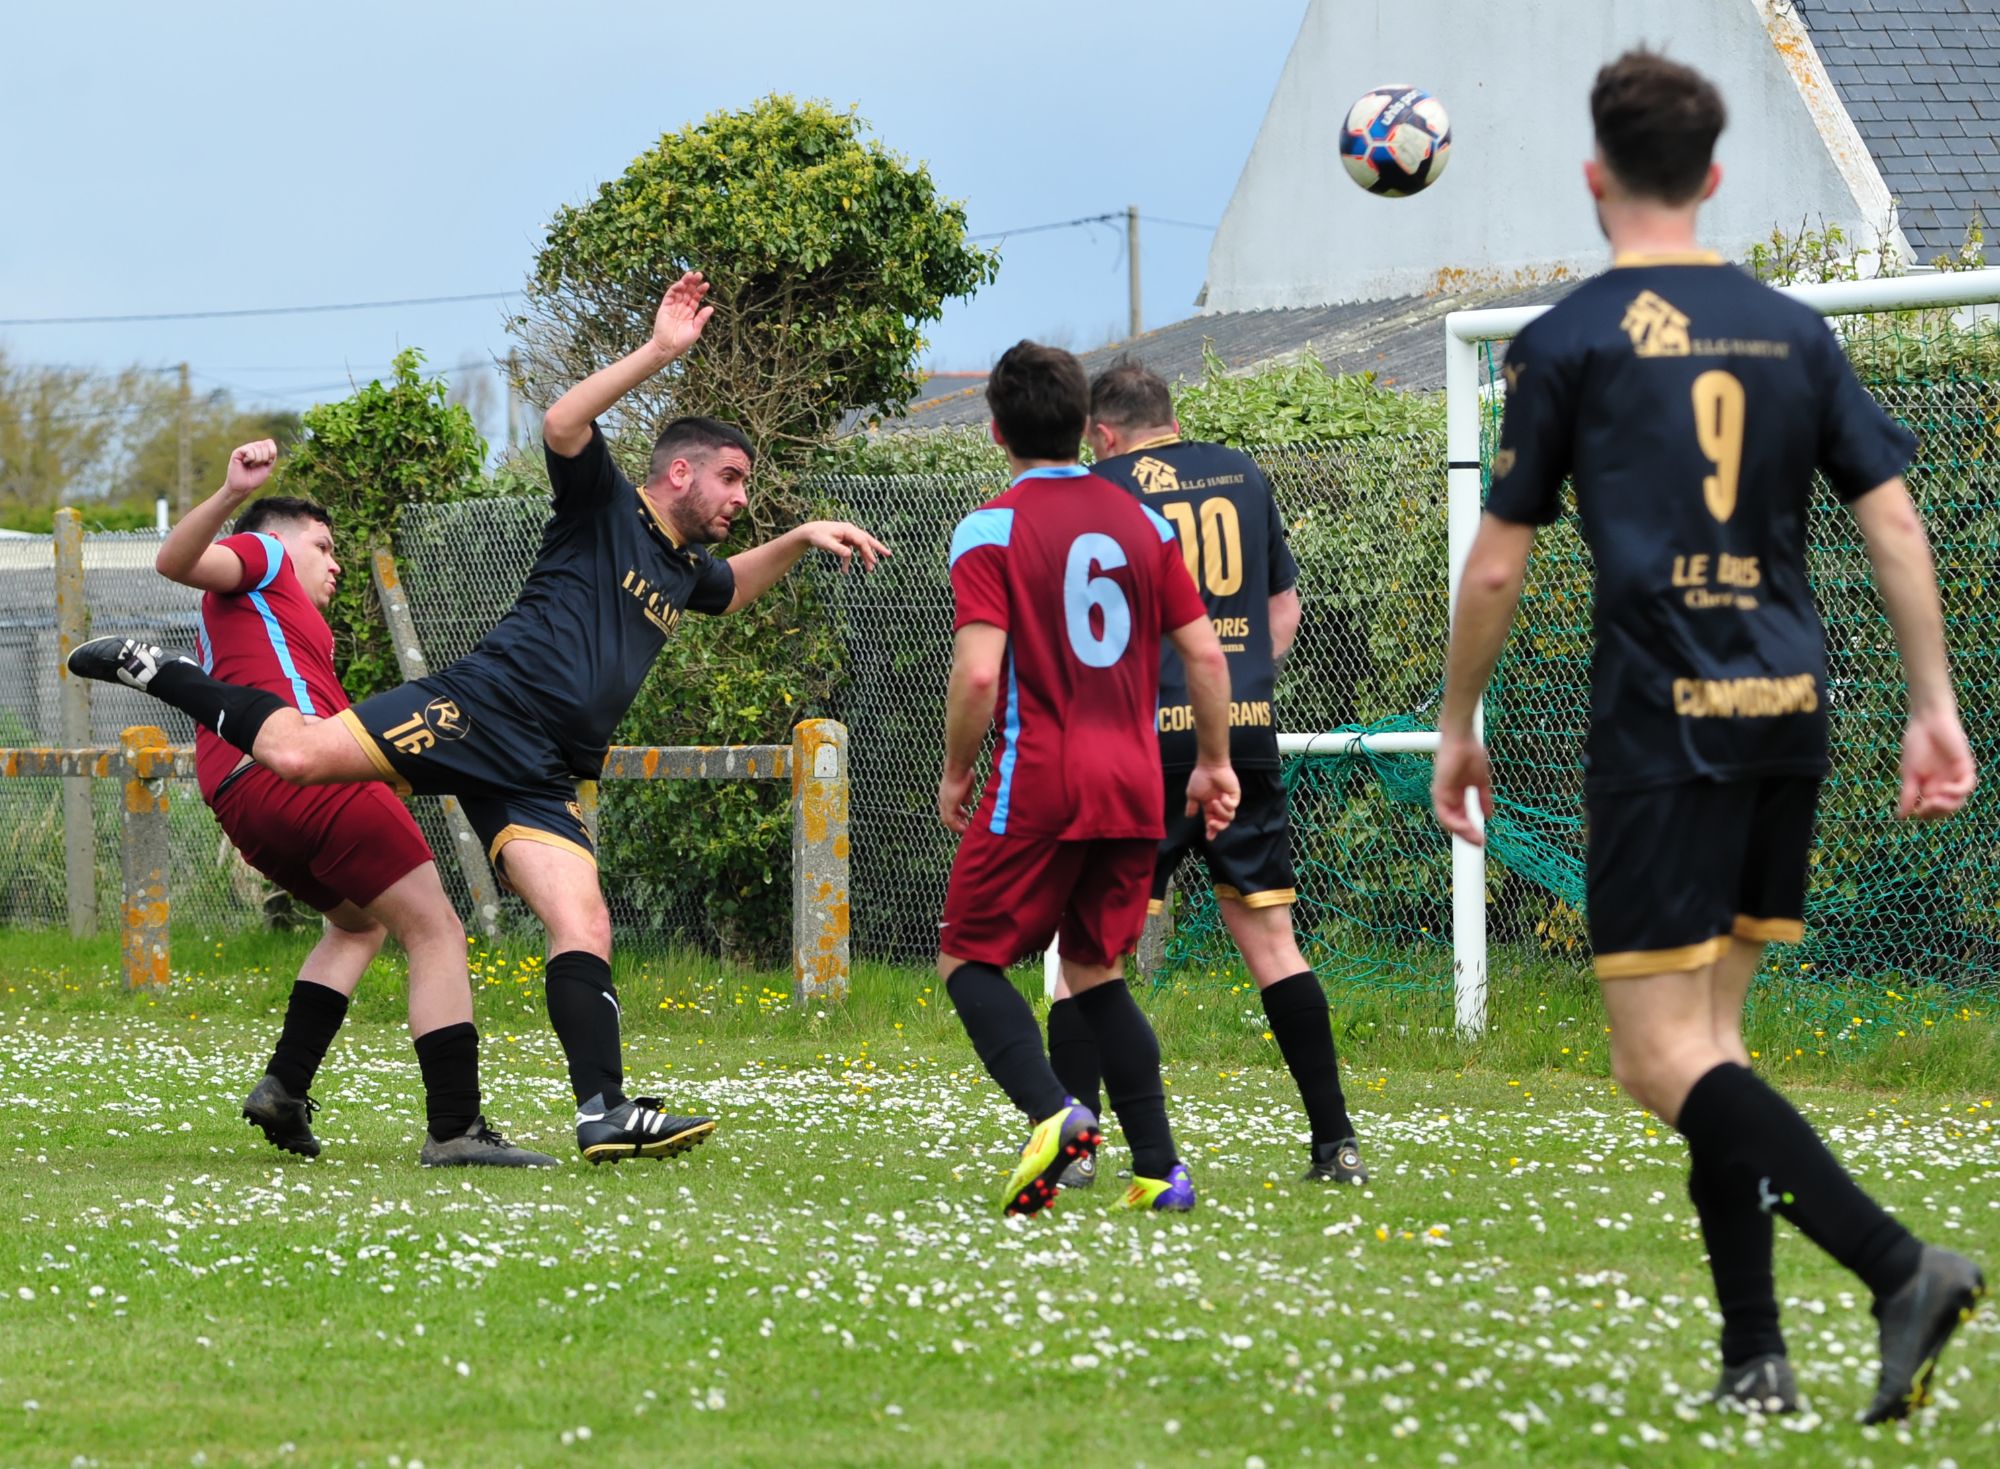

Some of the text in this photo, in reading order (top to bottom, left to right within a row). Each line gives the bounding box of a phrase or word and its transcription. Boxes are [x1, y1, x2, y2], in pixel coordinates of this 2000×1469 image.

[1691, 369, 1745, 524] 9
[1163, 496, 1243, 596] 10
[1672, 554, 1709, 586] LE
[1064, 532, 1131, 668] 6
[1211, 617, 1250, 638] ORIS
[383, 712, 435, 755] 16
[1159, 701, 1271, 732] CORRANS
